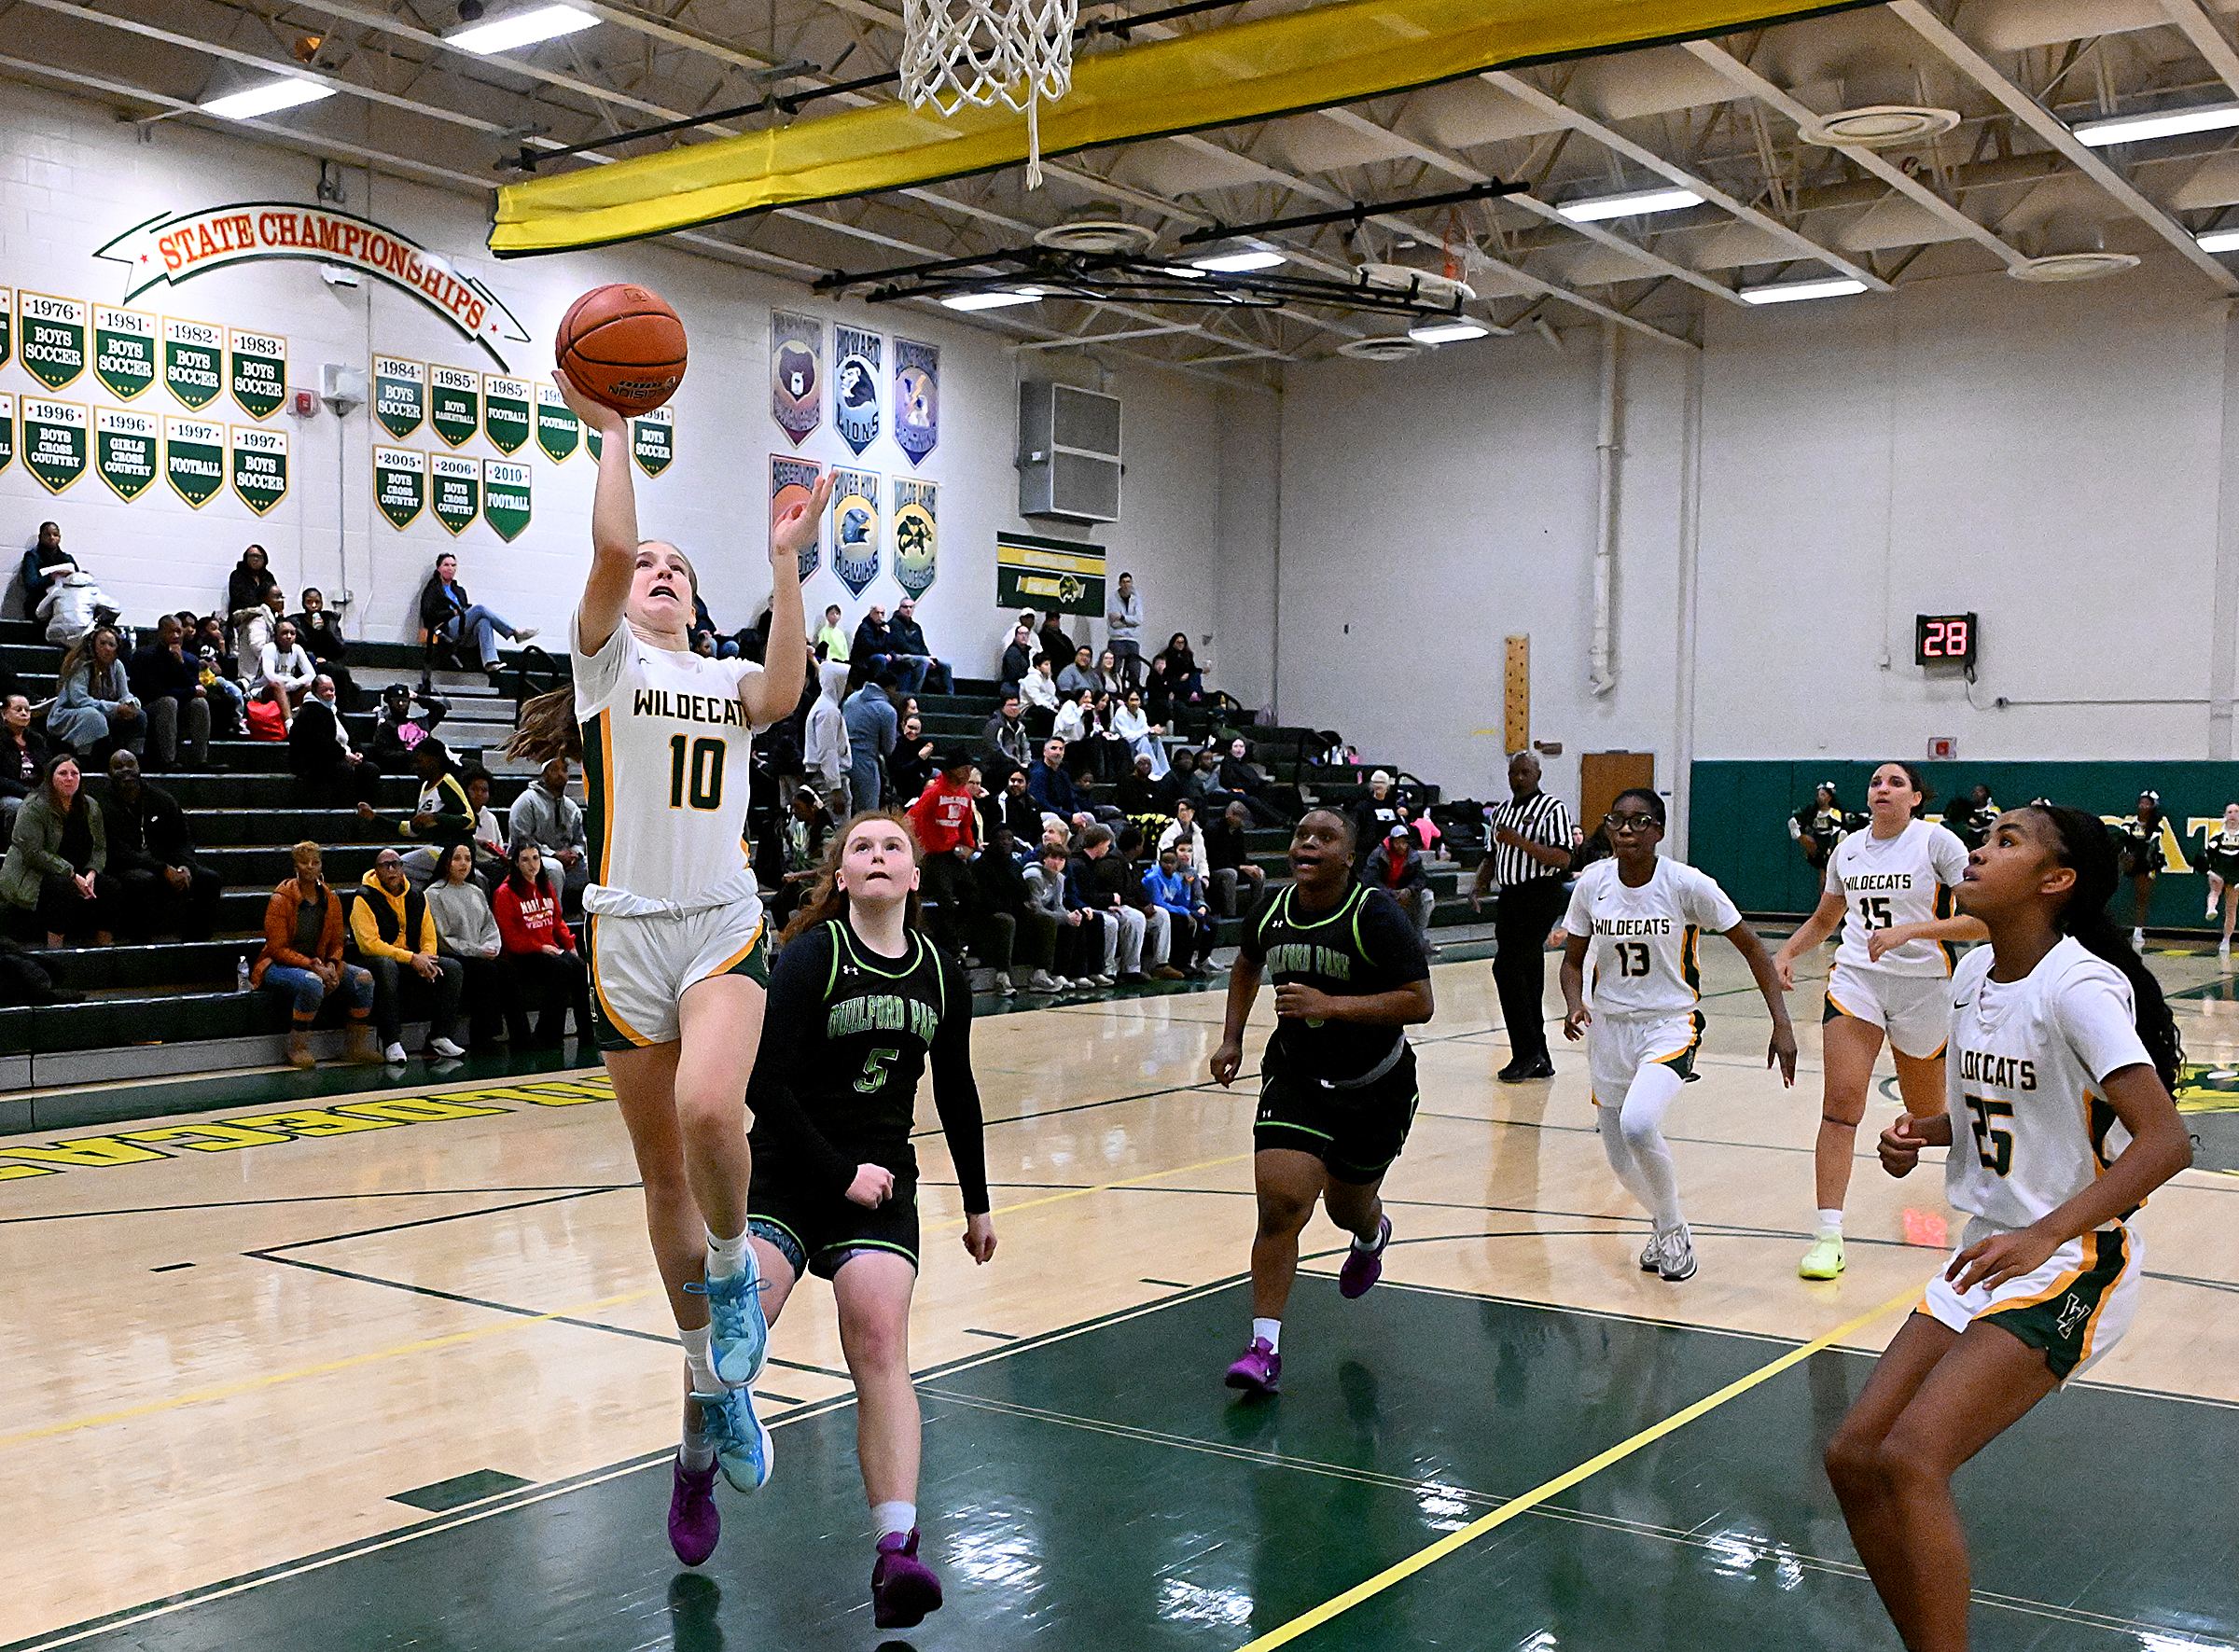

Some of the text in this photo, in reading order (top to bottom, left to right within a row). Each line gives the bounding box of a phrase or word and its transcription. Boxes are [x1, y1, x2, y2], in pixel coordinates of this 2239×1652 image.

[159, 212, 486, 329] STATE CHAMPIONSHIPS
[33, 298, 74, 320] 1976
[106, 312, 144, 332] 1981
[34, 326, 73, 346] BOYS
[174, 325, 213, 343] 1982
[107, 338, 144, 359] BOYS
[240, 336, 277, 354] 1983
[25, 342, 82, 367] SOCCER
[175, 349, 211, 369] BOYS
[98, 354, 153, 378] SOCCER
[242, 360, 275, 380] BOYS
[382, 361, 416, 379] 1984
[168, 365, 219, 388] SOCCER
[439, 371, 471, 388] 1985
[234, 376, 283, 397] SOCCER
[384, 384, 414, 403] BOYS
[493, 381, 522, 397] 1985
[543, 389, 564, 403] 199
[36, 404, 75, 422] 1996
[378, 399, 422, 419] SOCCER
[435, 410, 475, 425] BASKETBALL
[487, 408, 529, 423] FOOTBALL
[109, 415, 146, 432] 1996
[178, 423, 212, 439] 1997
[538, 415, 578, 432] FOOTBALL
[39, 427, 72, 443] BOYS
[243, 434, 276, 448] 1997
[642, 429, 665, 443] BOYS
[38, 441, 74, 455] CROSS
[110, 437, 146, 453] GIRLS
[635, 442, 671, 459] SOCCER
[31, 451, 81, 468] COUNTRY
[111, 451, 145, 465] CROSS
[169, 456, 221, 478] FOOTBALL
[244, 455, 276, 473] BOYS
[383, 452, 416, 467] 2005
[104, 460, 152, 477] COUNTRY
[440, 461, 471, 474] 2006
[494, 465, 522, 482] 2010
[236, 471, 285, 491] SOCCER
[387, 472, 412, 486] BOYS
[444, 482, 467, 494] BOYS
[386, 485, 413, 496] CROSS
[443, 493, 468, 505] CROSS
[381, 493, 420, 507] COUNTRY
[438, 503, 474, 515] COUNTRY
[487, 493, 530, 511] FOOTBALL
[1924, 621, 1968, 657] 28
[669, 733, 727, 812] 10
[1859, 896, 1892, 930] 15
[1592, 918, 1670, 936] WILDECATS
[1614, 942, 1650, 977] 13
[827, 994, 905, 1040] GUILFORD
[853, 1048, 900, 1094] 5
[0, 1075, 618, 1182] ILDECA
